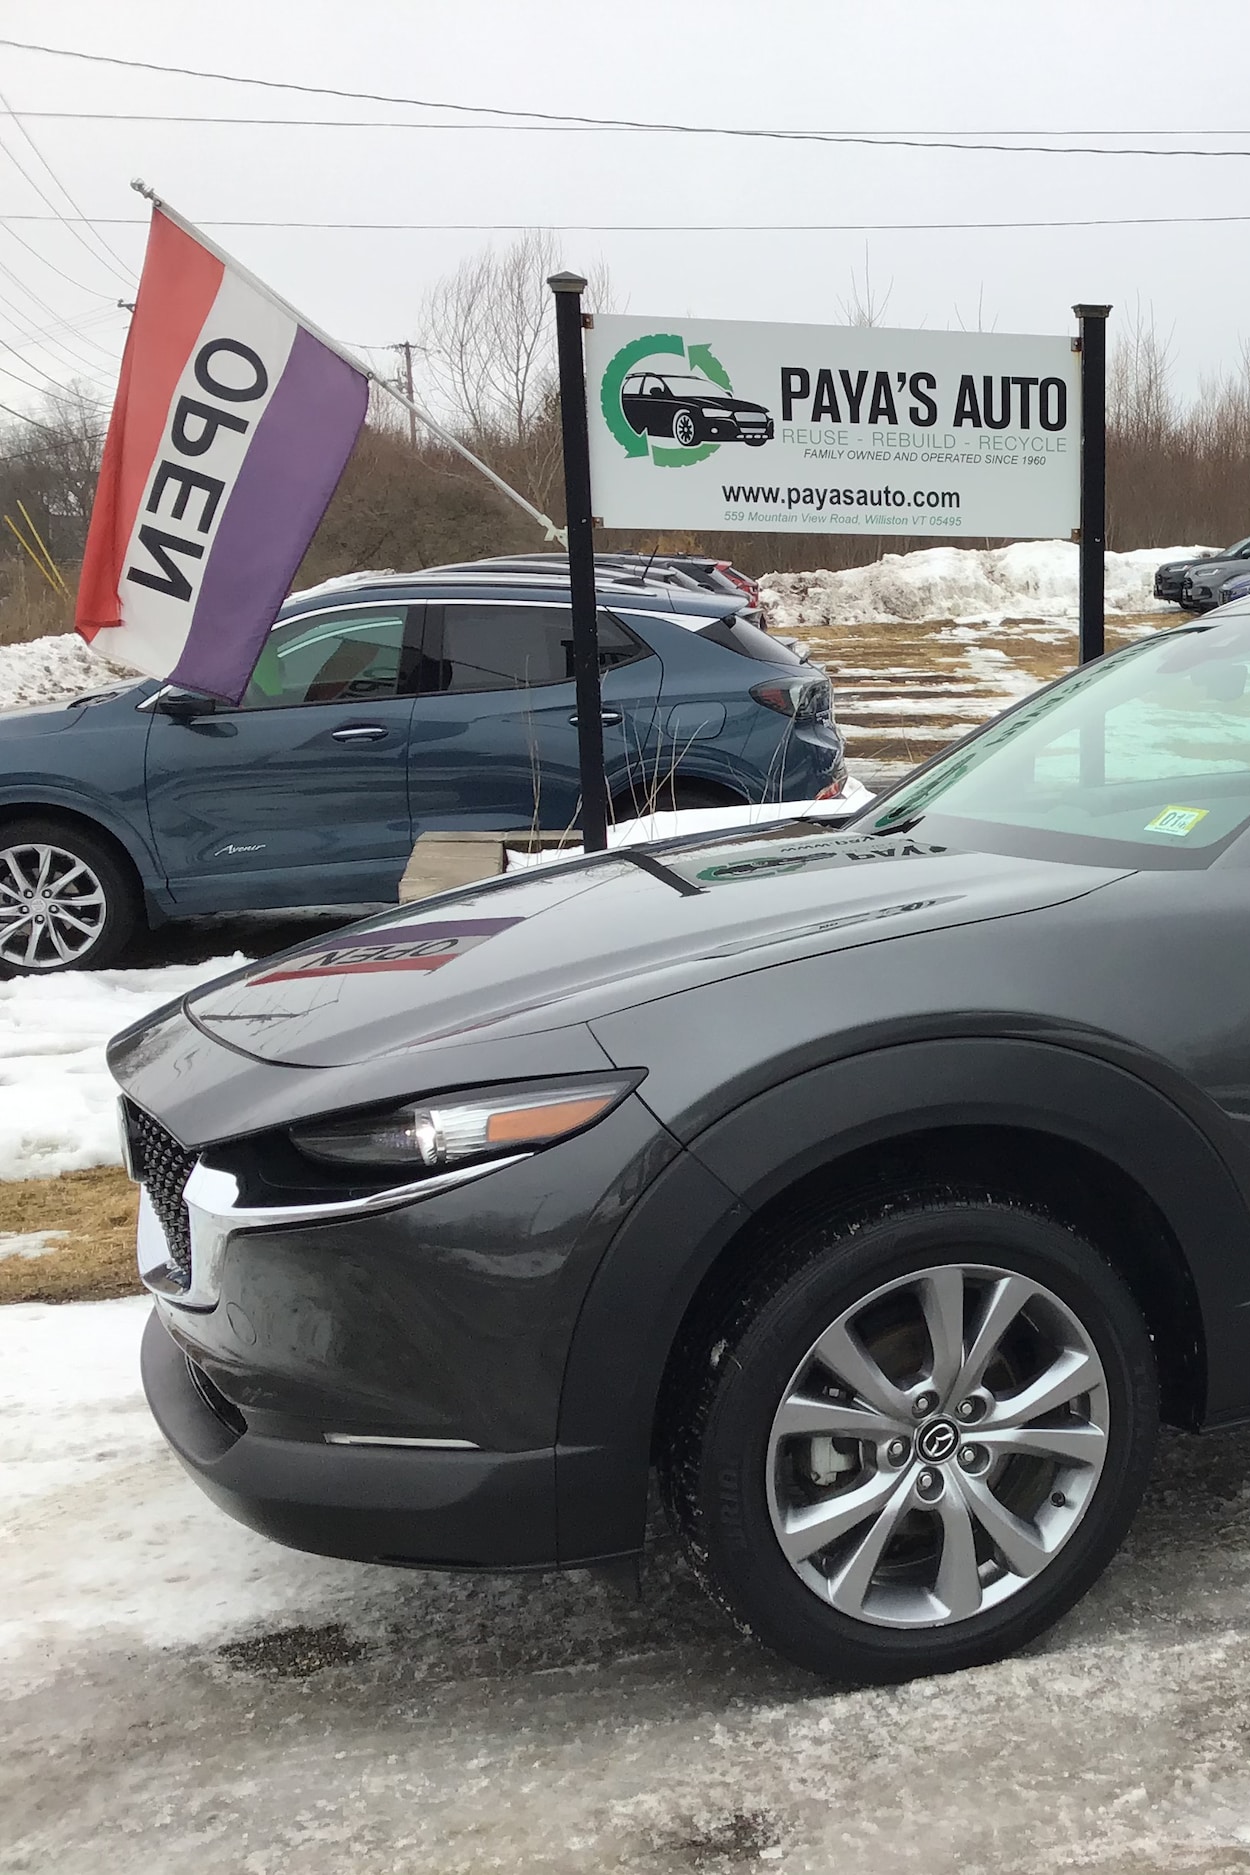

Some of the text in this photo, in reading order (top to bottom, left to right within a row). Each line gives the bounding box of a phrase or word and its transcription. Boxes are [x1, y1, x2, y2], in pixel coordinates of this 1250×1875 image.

[781, 366, 1067, 431] PAYA'S AUTO
[782, 428, 849, 446] REUSE
[872, 431, 956, 449] REBUILD
[979, 435, 1067, 453] RECYCLE
[803, 448, 1047, 466] FAMILY OWNED AND OPERATED SINCE 1960
[721, 485, 961, 511] www.payasauto.com
[723, 511, 963, 527] 559 Mountain View Road, Williston VT 05495
[214, 844, 267, 857] Avenir
